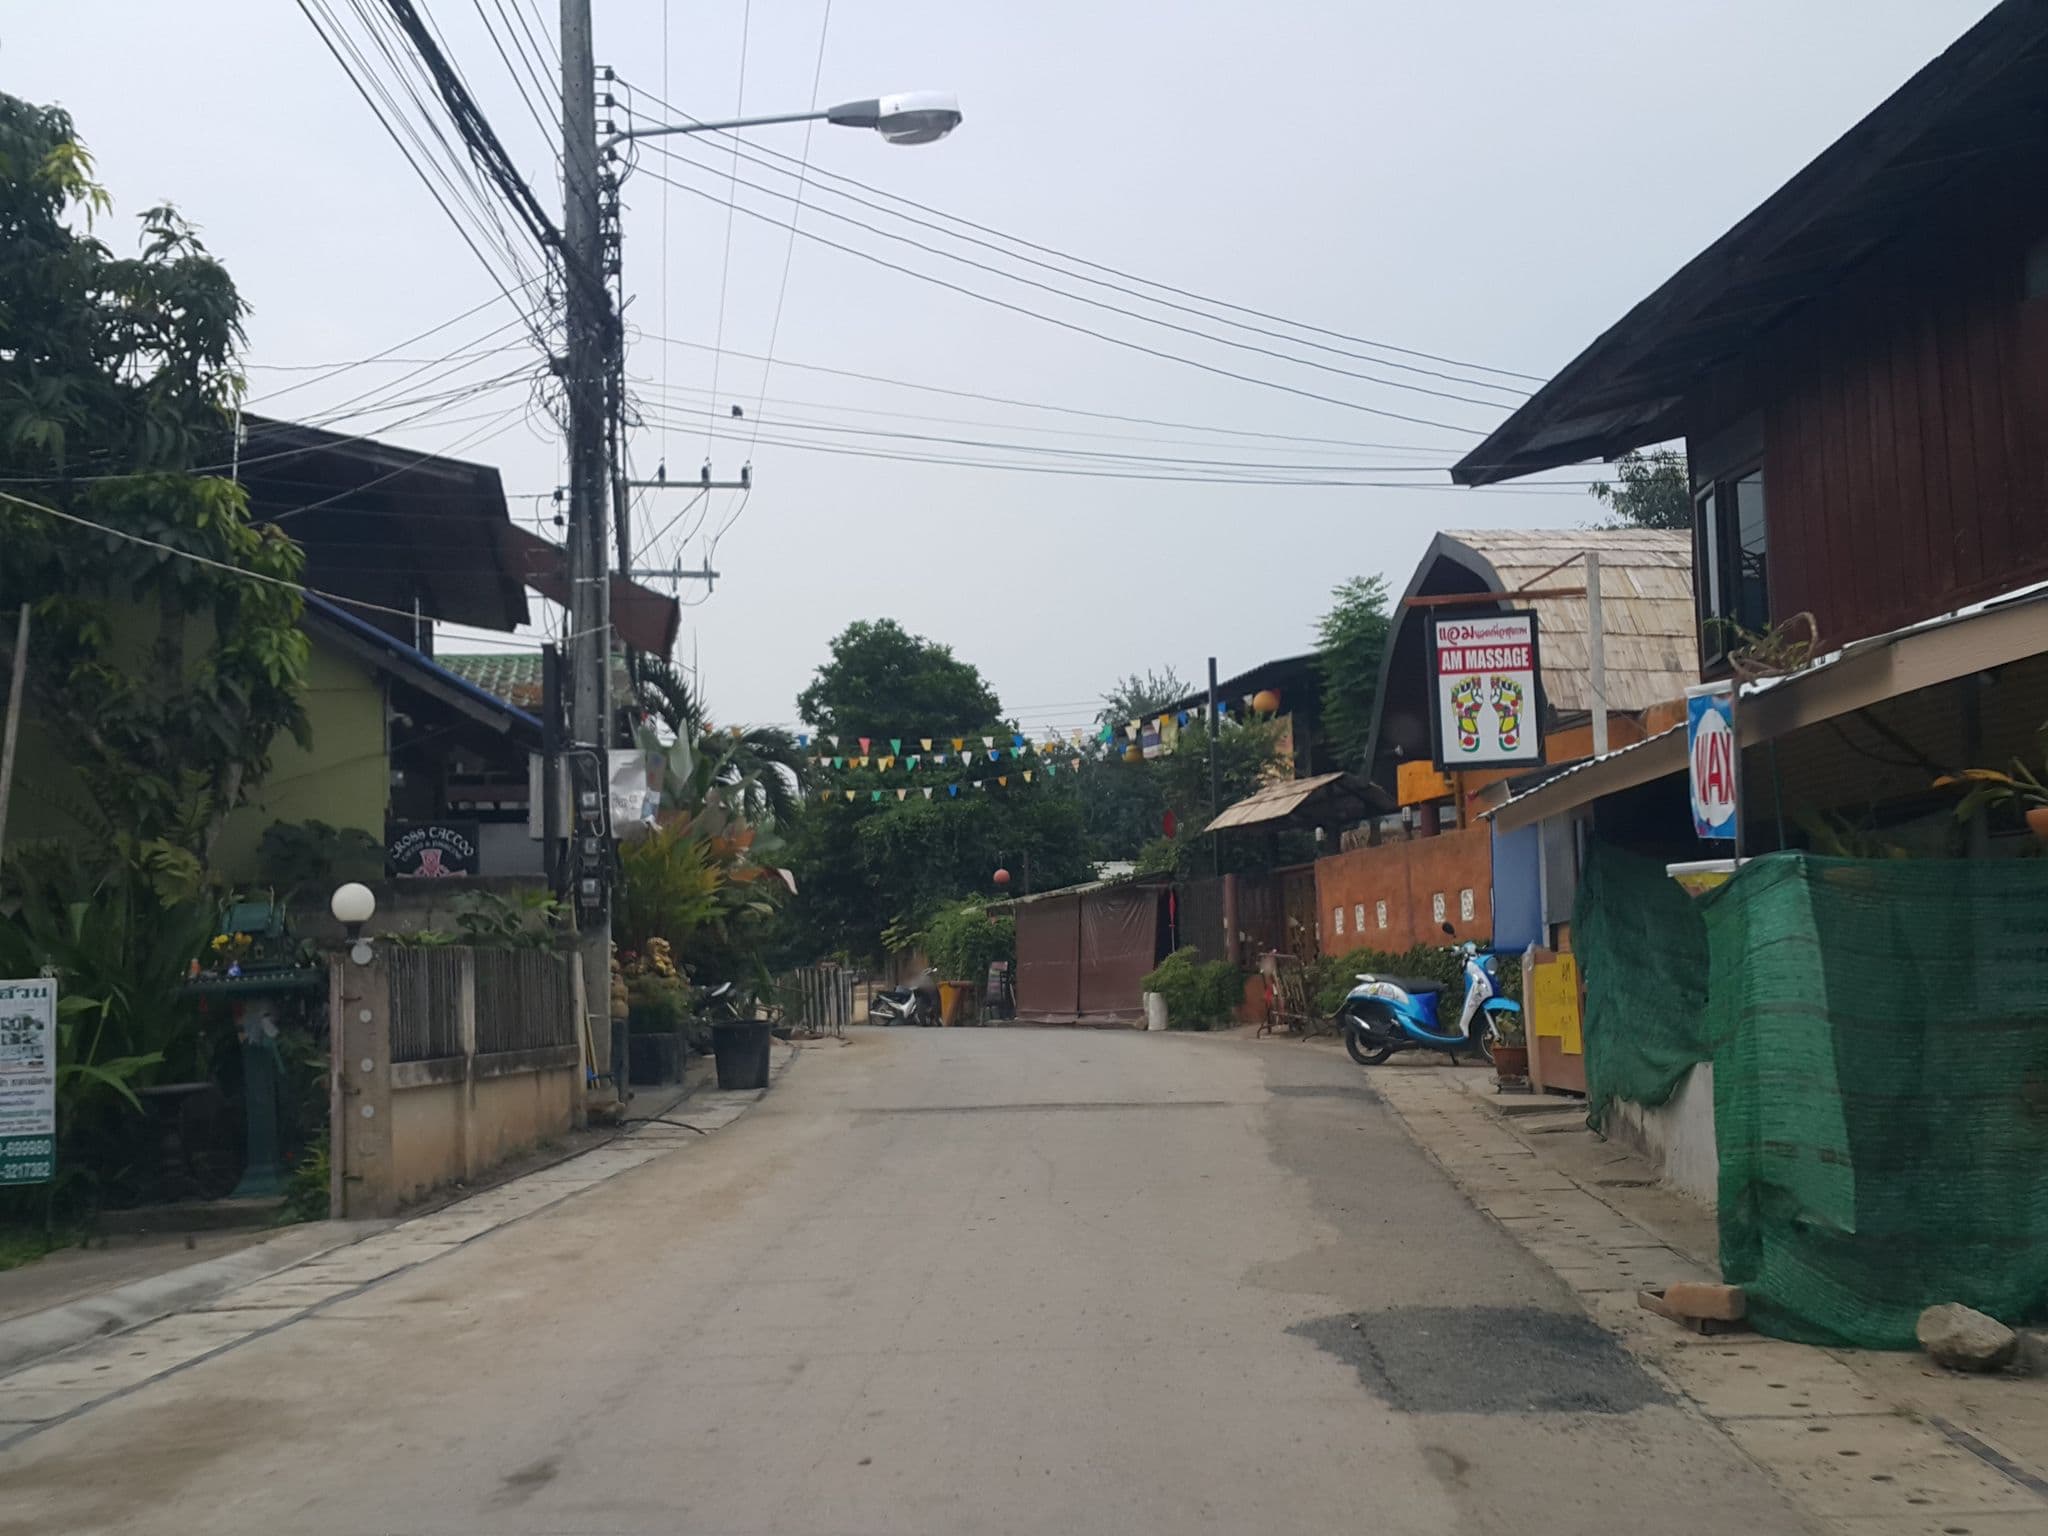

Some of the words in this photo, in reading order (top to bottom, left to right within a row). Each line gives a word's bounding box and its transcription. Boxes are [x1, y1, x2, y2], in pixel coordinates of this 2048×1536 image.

[1442, 649, 1463, 671] AM
[1465, 646, 1529, 670] MASSAGE
[1695, 731, 1736, 805] WAX
